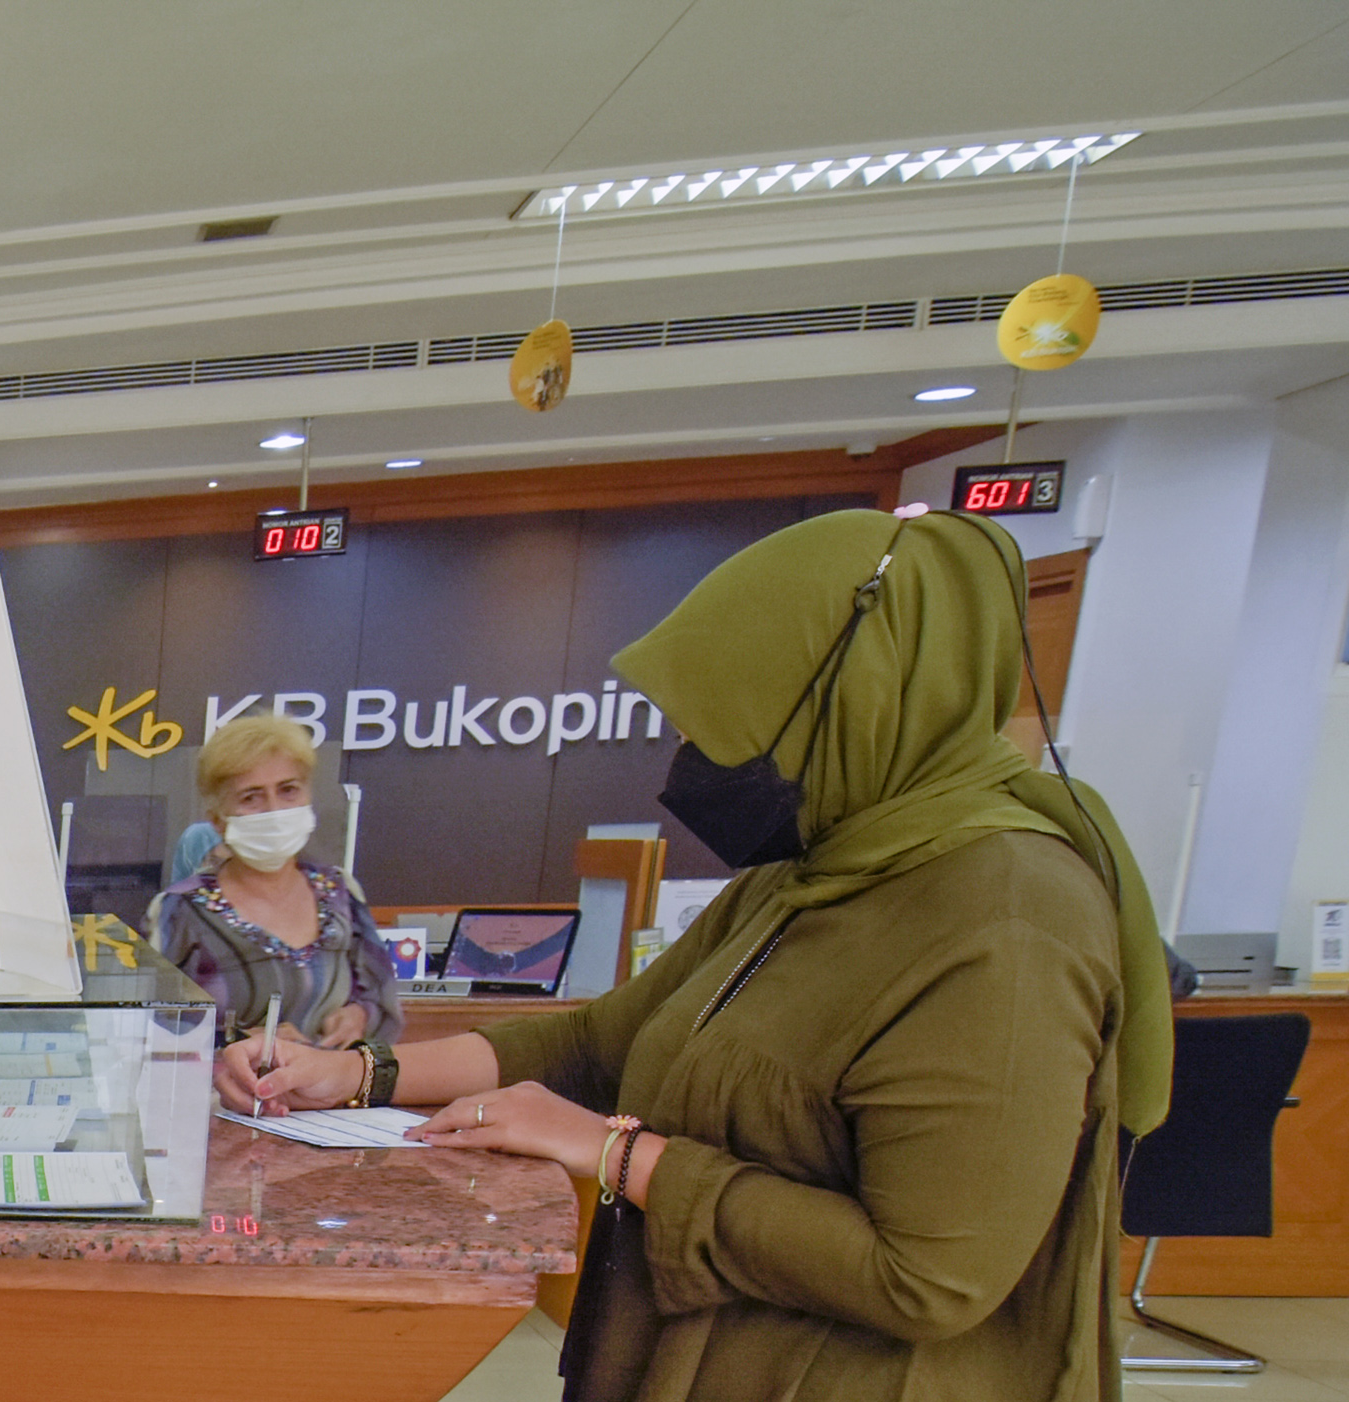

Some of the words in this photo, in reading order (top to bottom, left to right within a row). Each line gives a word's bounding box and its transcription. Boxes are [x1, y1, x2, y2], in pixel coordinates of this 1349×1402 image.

[965, 481, 1031, 510] 601
[1037, 480, 1054, 501] 3
[325, 525, 339, 545] 2
[342, 680, 663, 757] Bukopin
[412, 983, 448, 993] DEA
